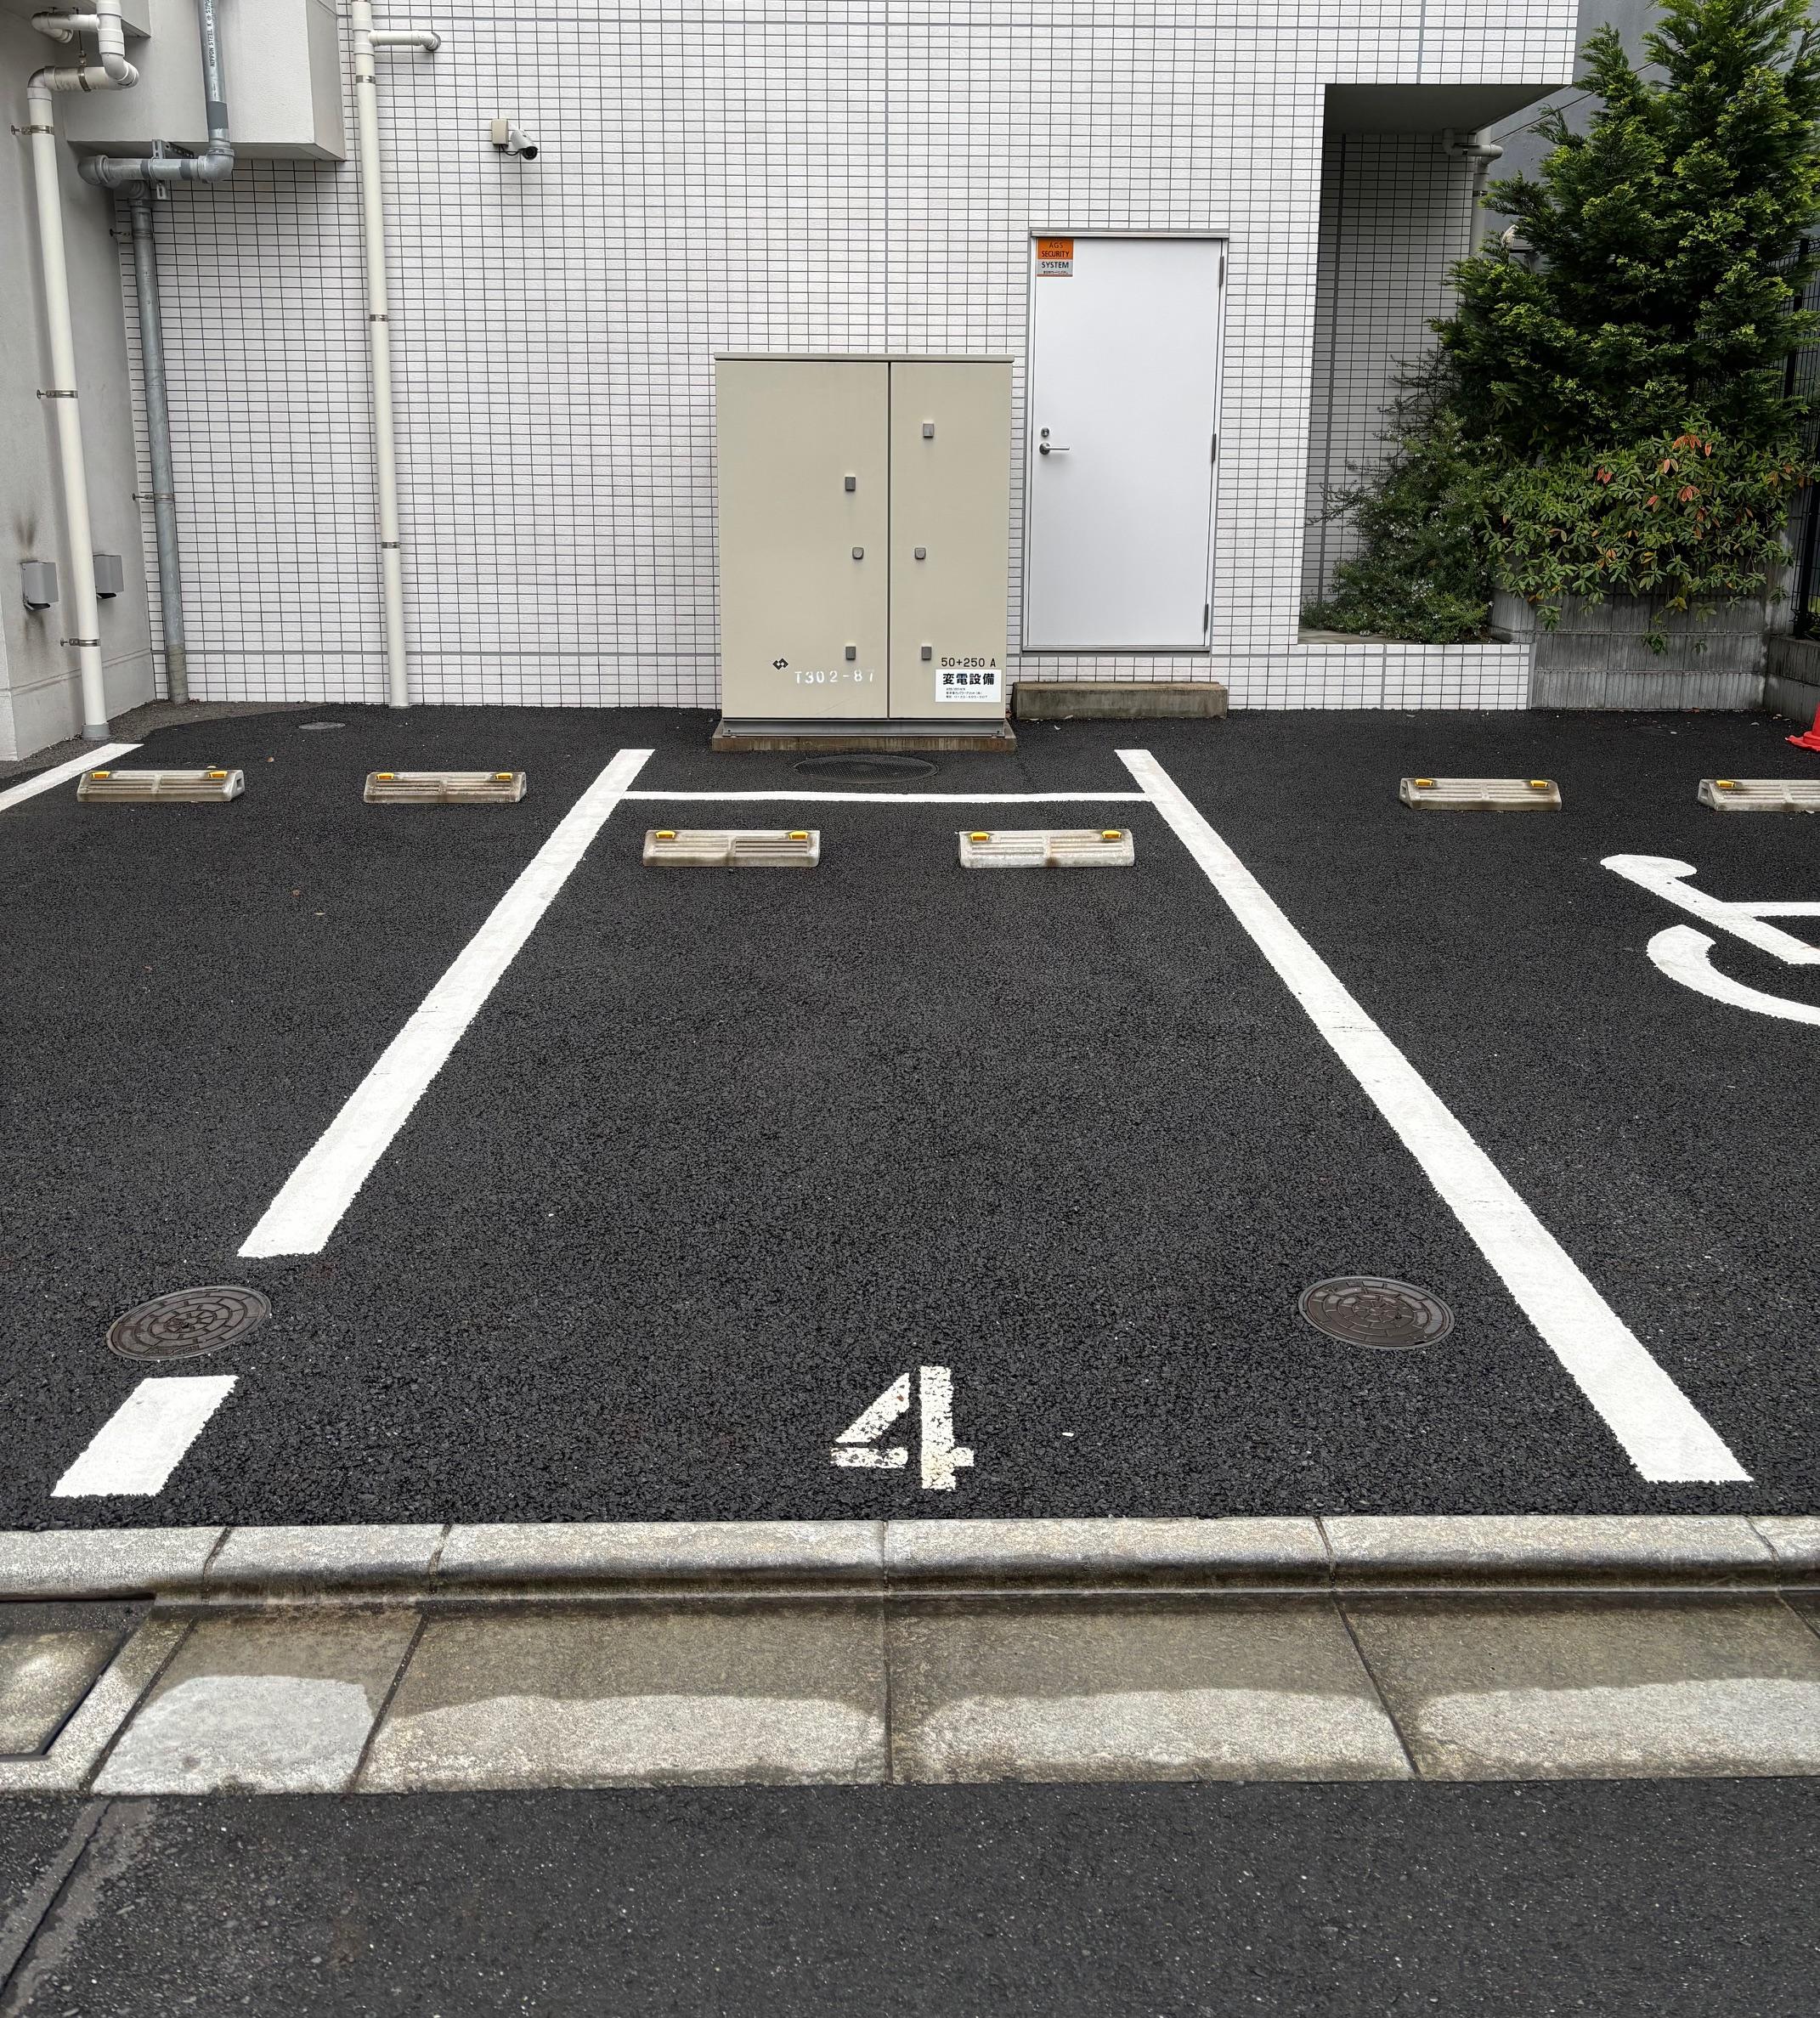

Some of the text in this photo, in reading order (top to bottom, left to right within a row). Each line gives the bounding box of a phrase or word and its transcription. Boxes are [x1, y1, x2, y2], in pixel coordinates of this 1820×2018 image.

[941, 657, 996, 668] 50+250 A
[942, 673, 995, 685] 変電設備
[829, 1365, 975, 1491] 4
